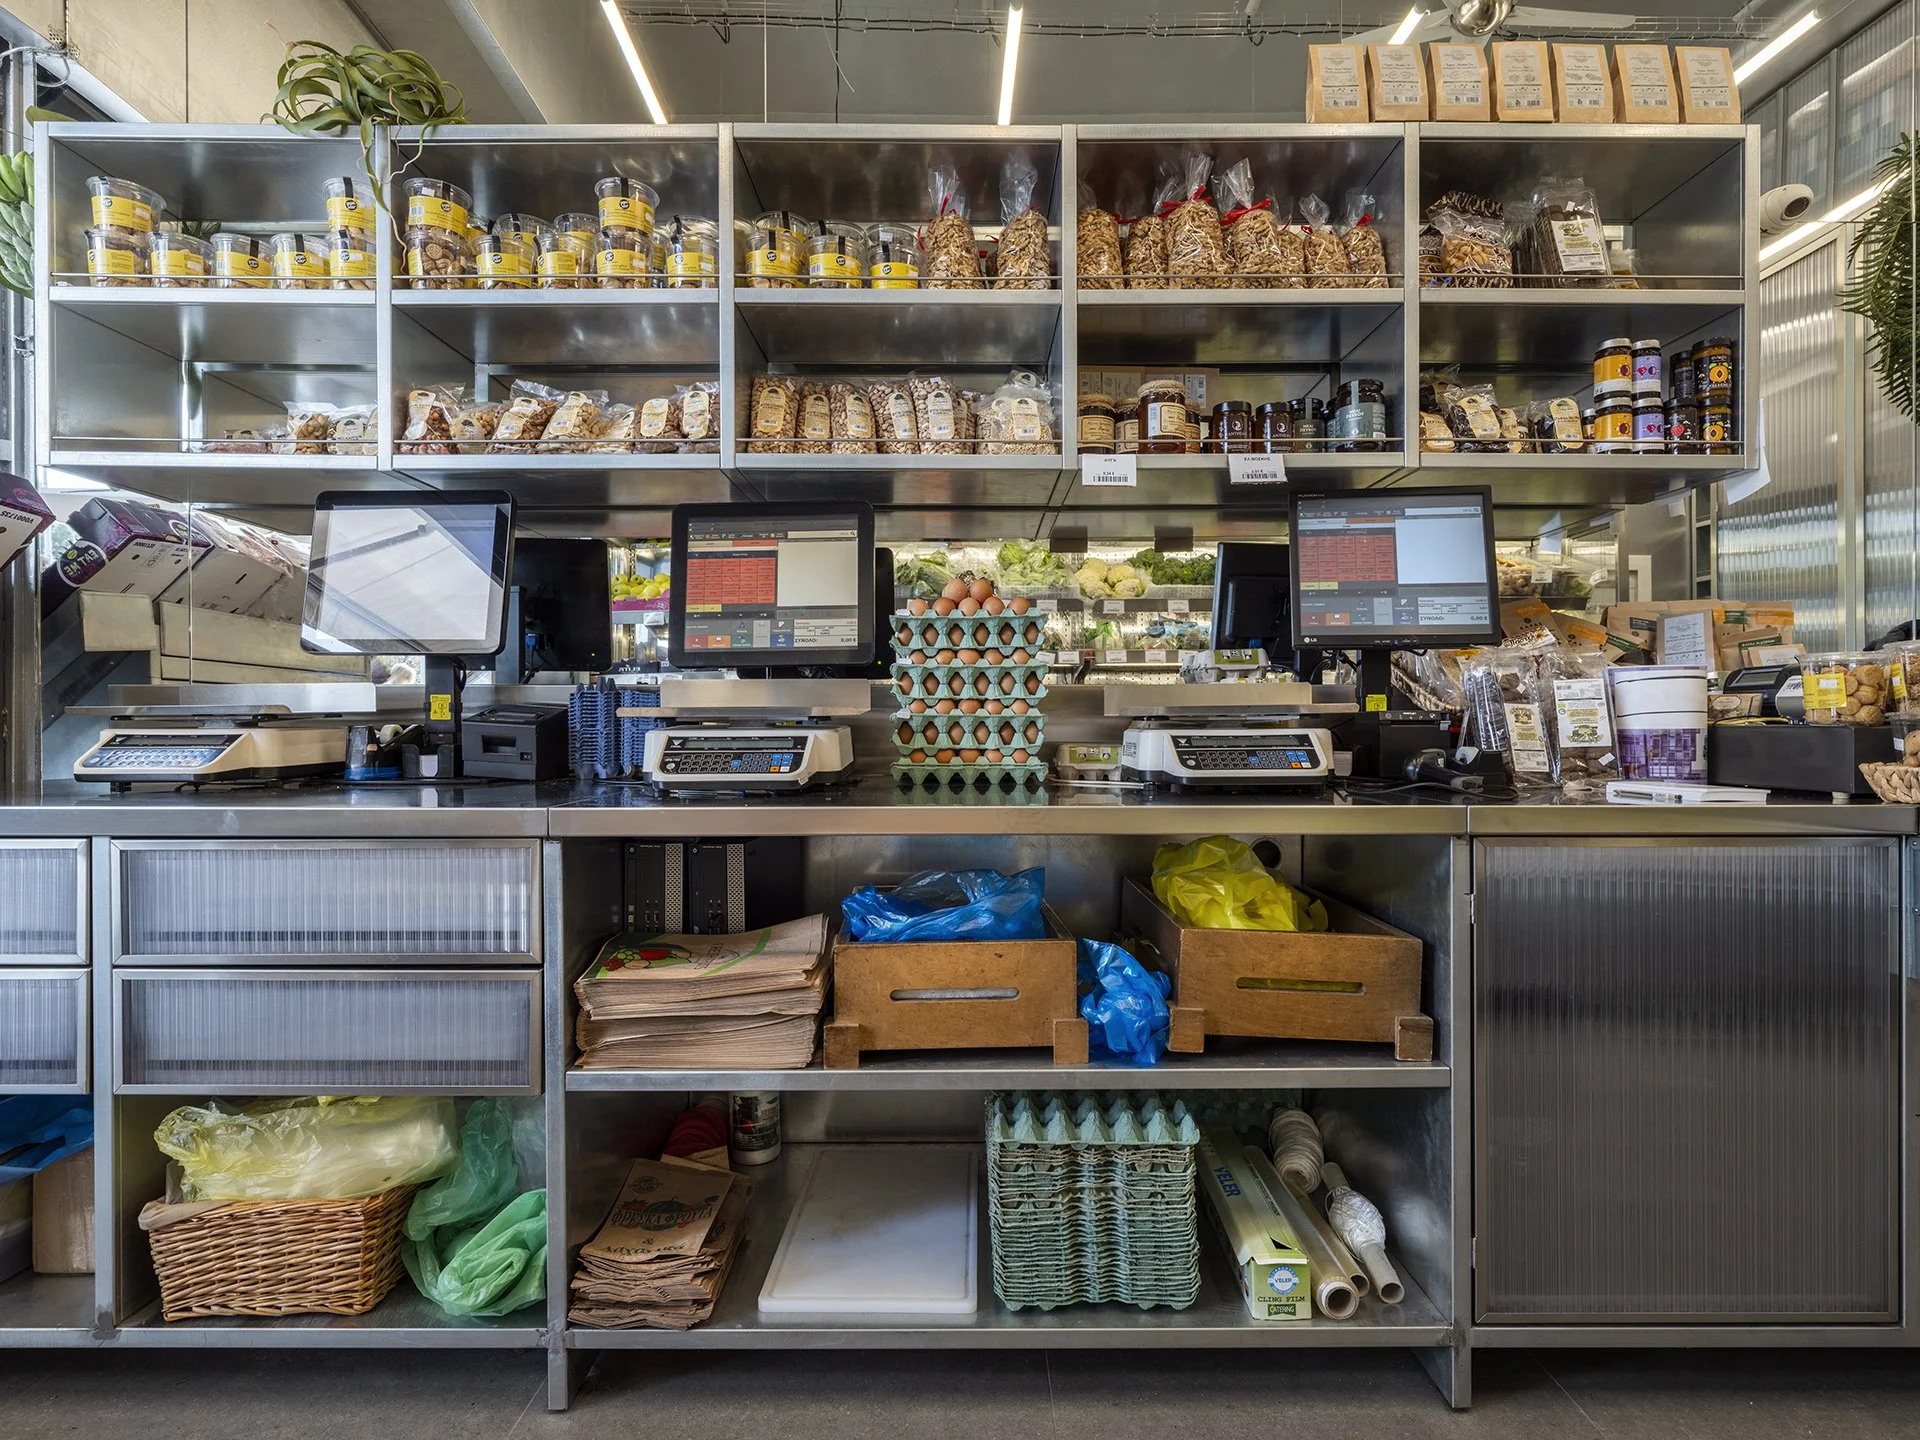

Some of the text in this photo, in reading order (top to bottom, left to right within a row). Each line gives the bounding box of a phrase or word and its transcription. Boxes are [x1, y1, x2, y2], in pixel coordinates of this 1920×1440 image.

[1214, 1166, 1241, 1198] VELER
[642, 1237, 655, 1246] &
[1269, 1305, 1295, 1313] CATERING
